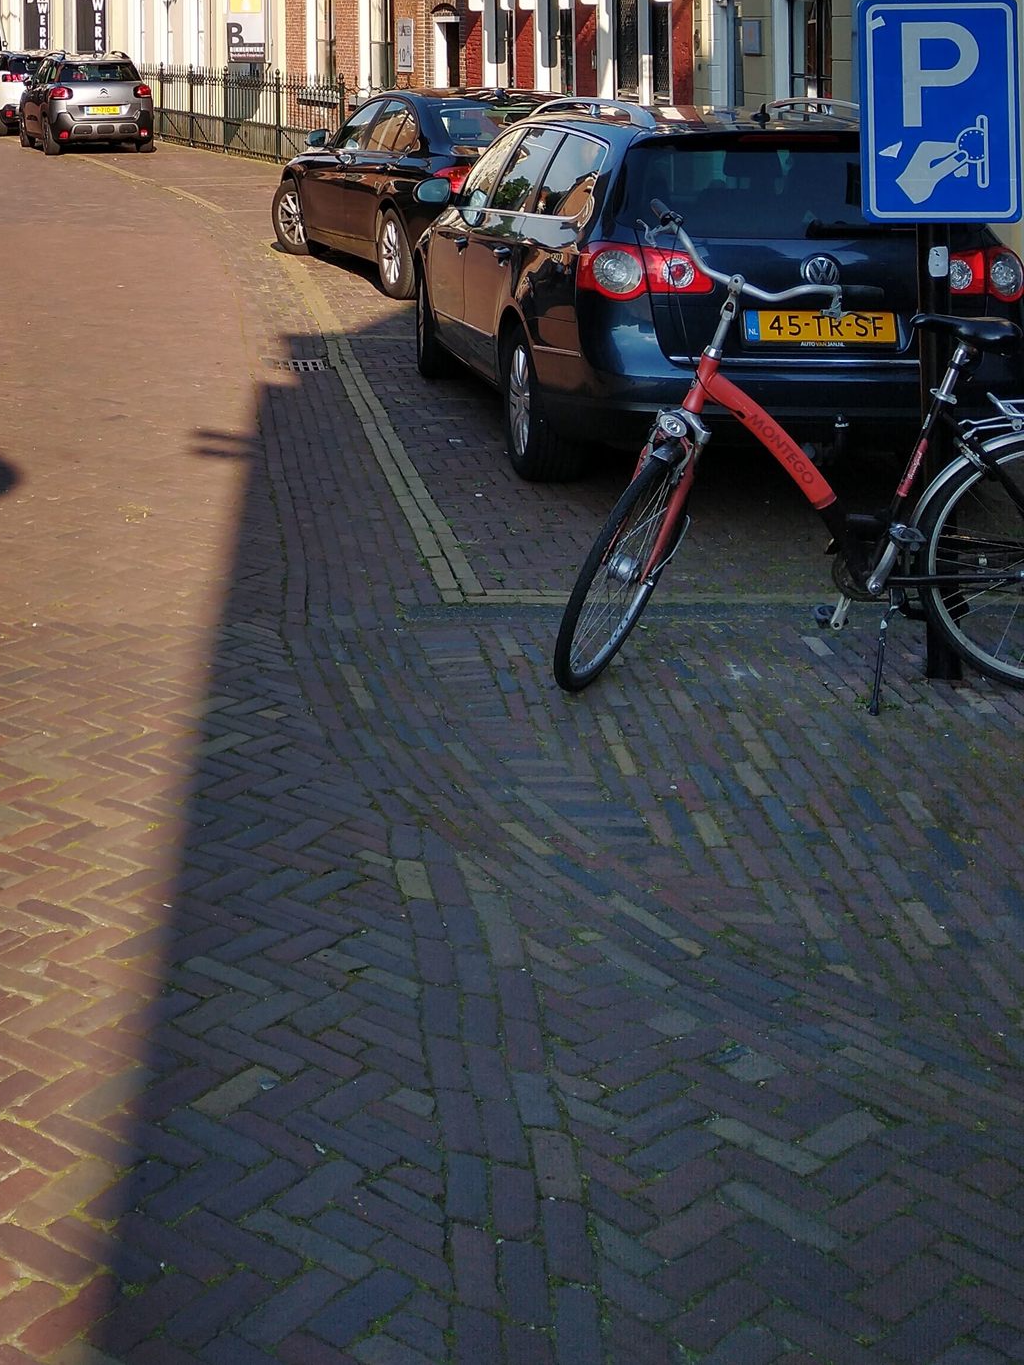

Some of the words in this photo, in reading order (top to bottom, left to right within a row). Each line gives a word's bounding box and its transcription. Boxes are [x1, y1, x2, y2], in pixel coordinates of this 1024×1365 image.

[901, 21, 980, 128] P
[748, 328, 758, 336] NL
[769, 315, 884, 337] 45-TR-SF
[745, 414, 814, 484] MONTEGO
